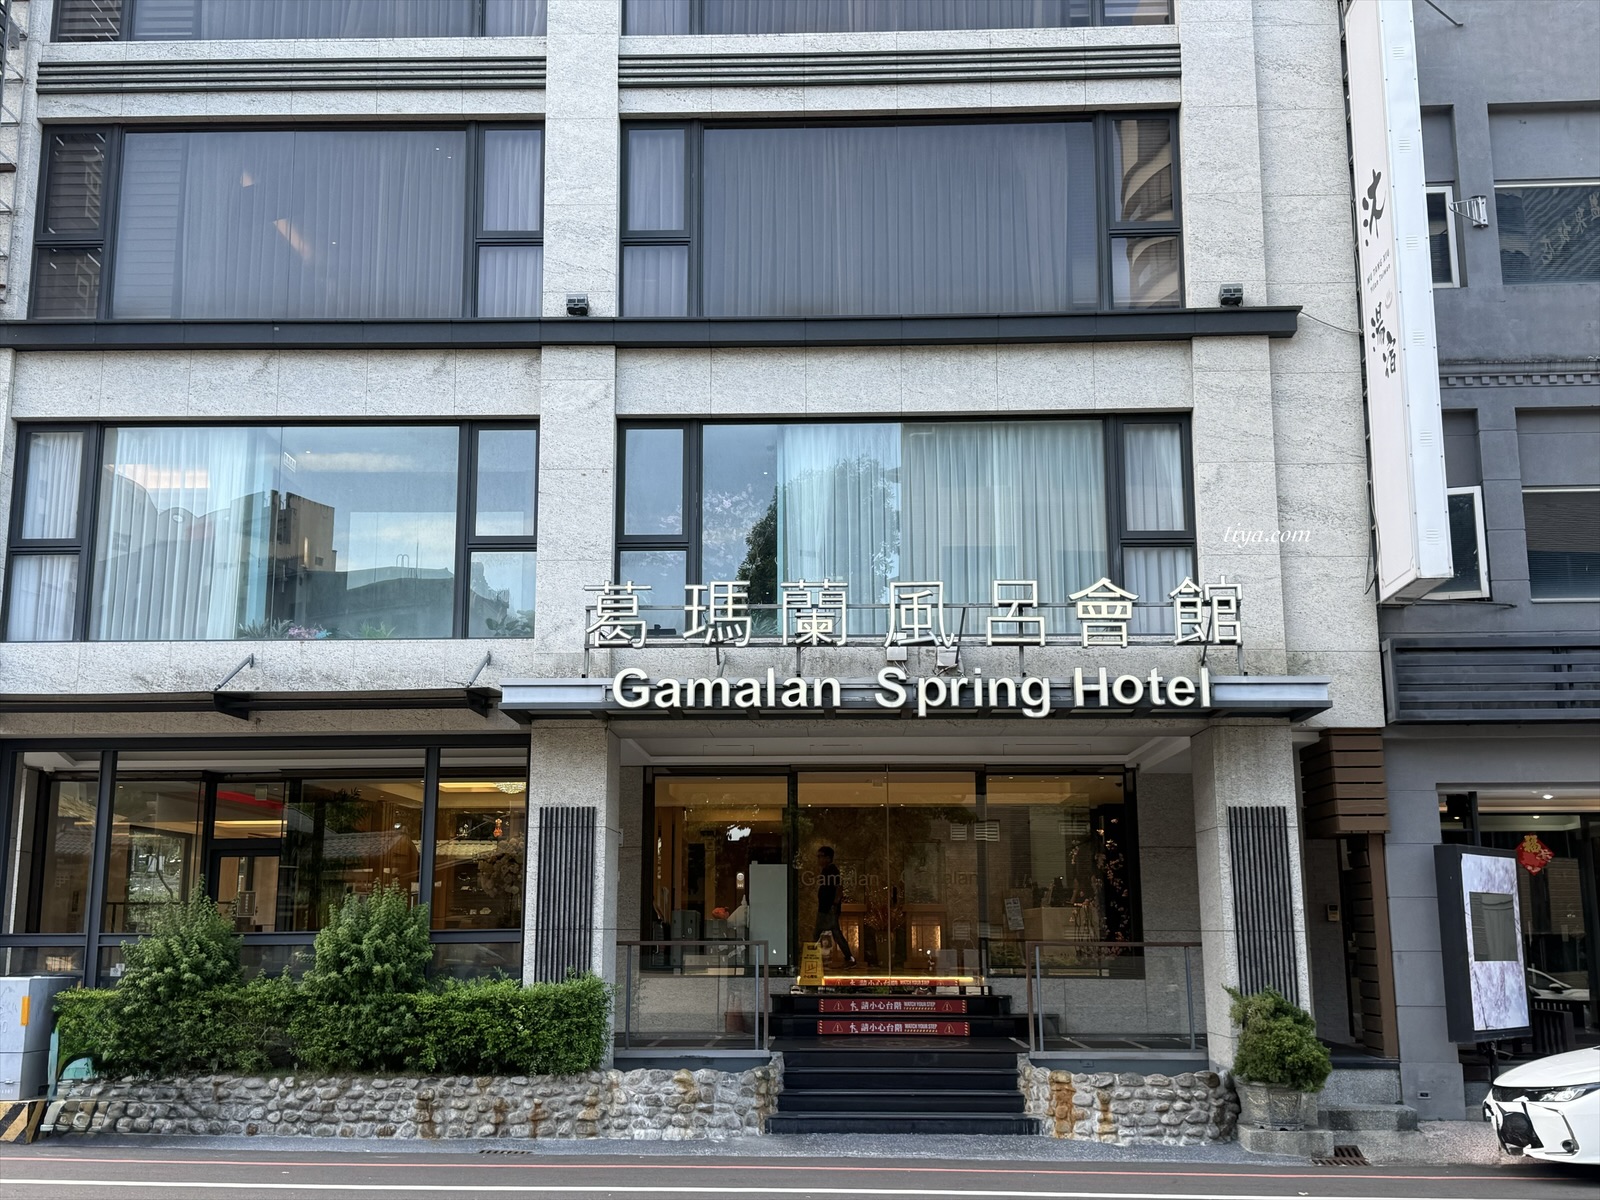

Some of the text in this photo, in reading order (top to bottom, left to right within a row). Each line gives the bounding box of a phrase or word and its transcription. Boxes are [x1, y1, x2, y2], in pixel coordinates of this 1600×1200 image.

[583, 577, 1242, 650] 葛瑪蘭風呂會館
[611, 666, 1212, 718] Gamalan Spring Hotel
